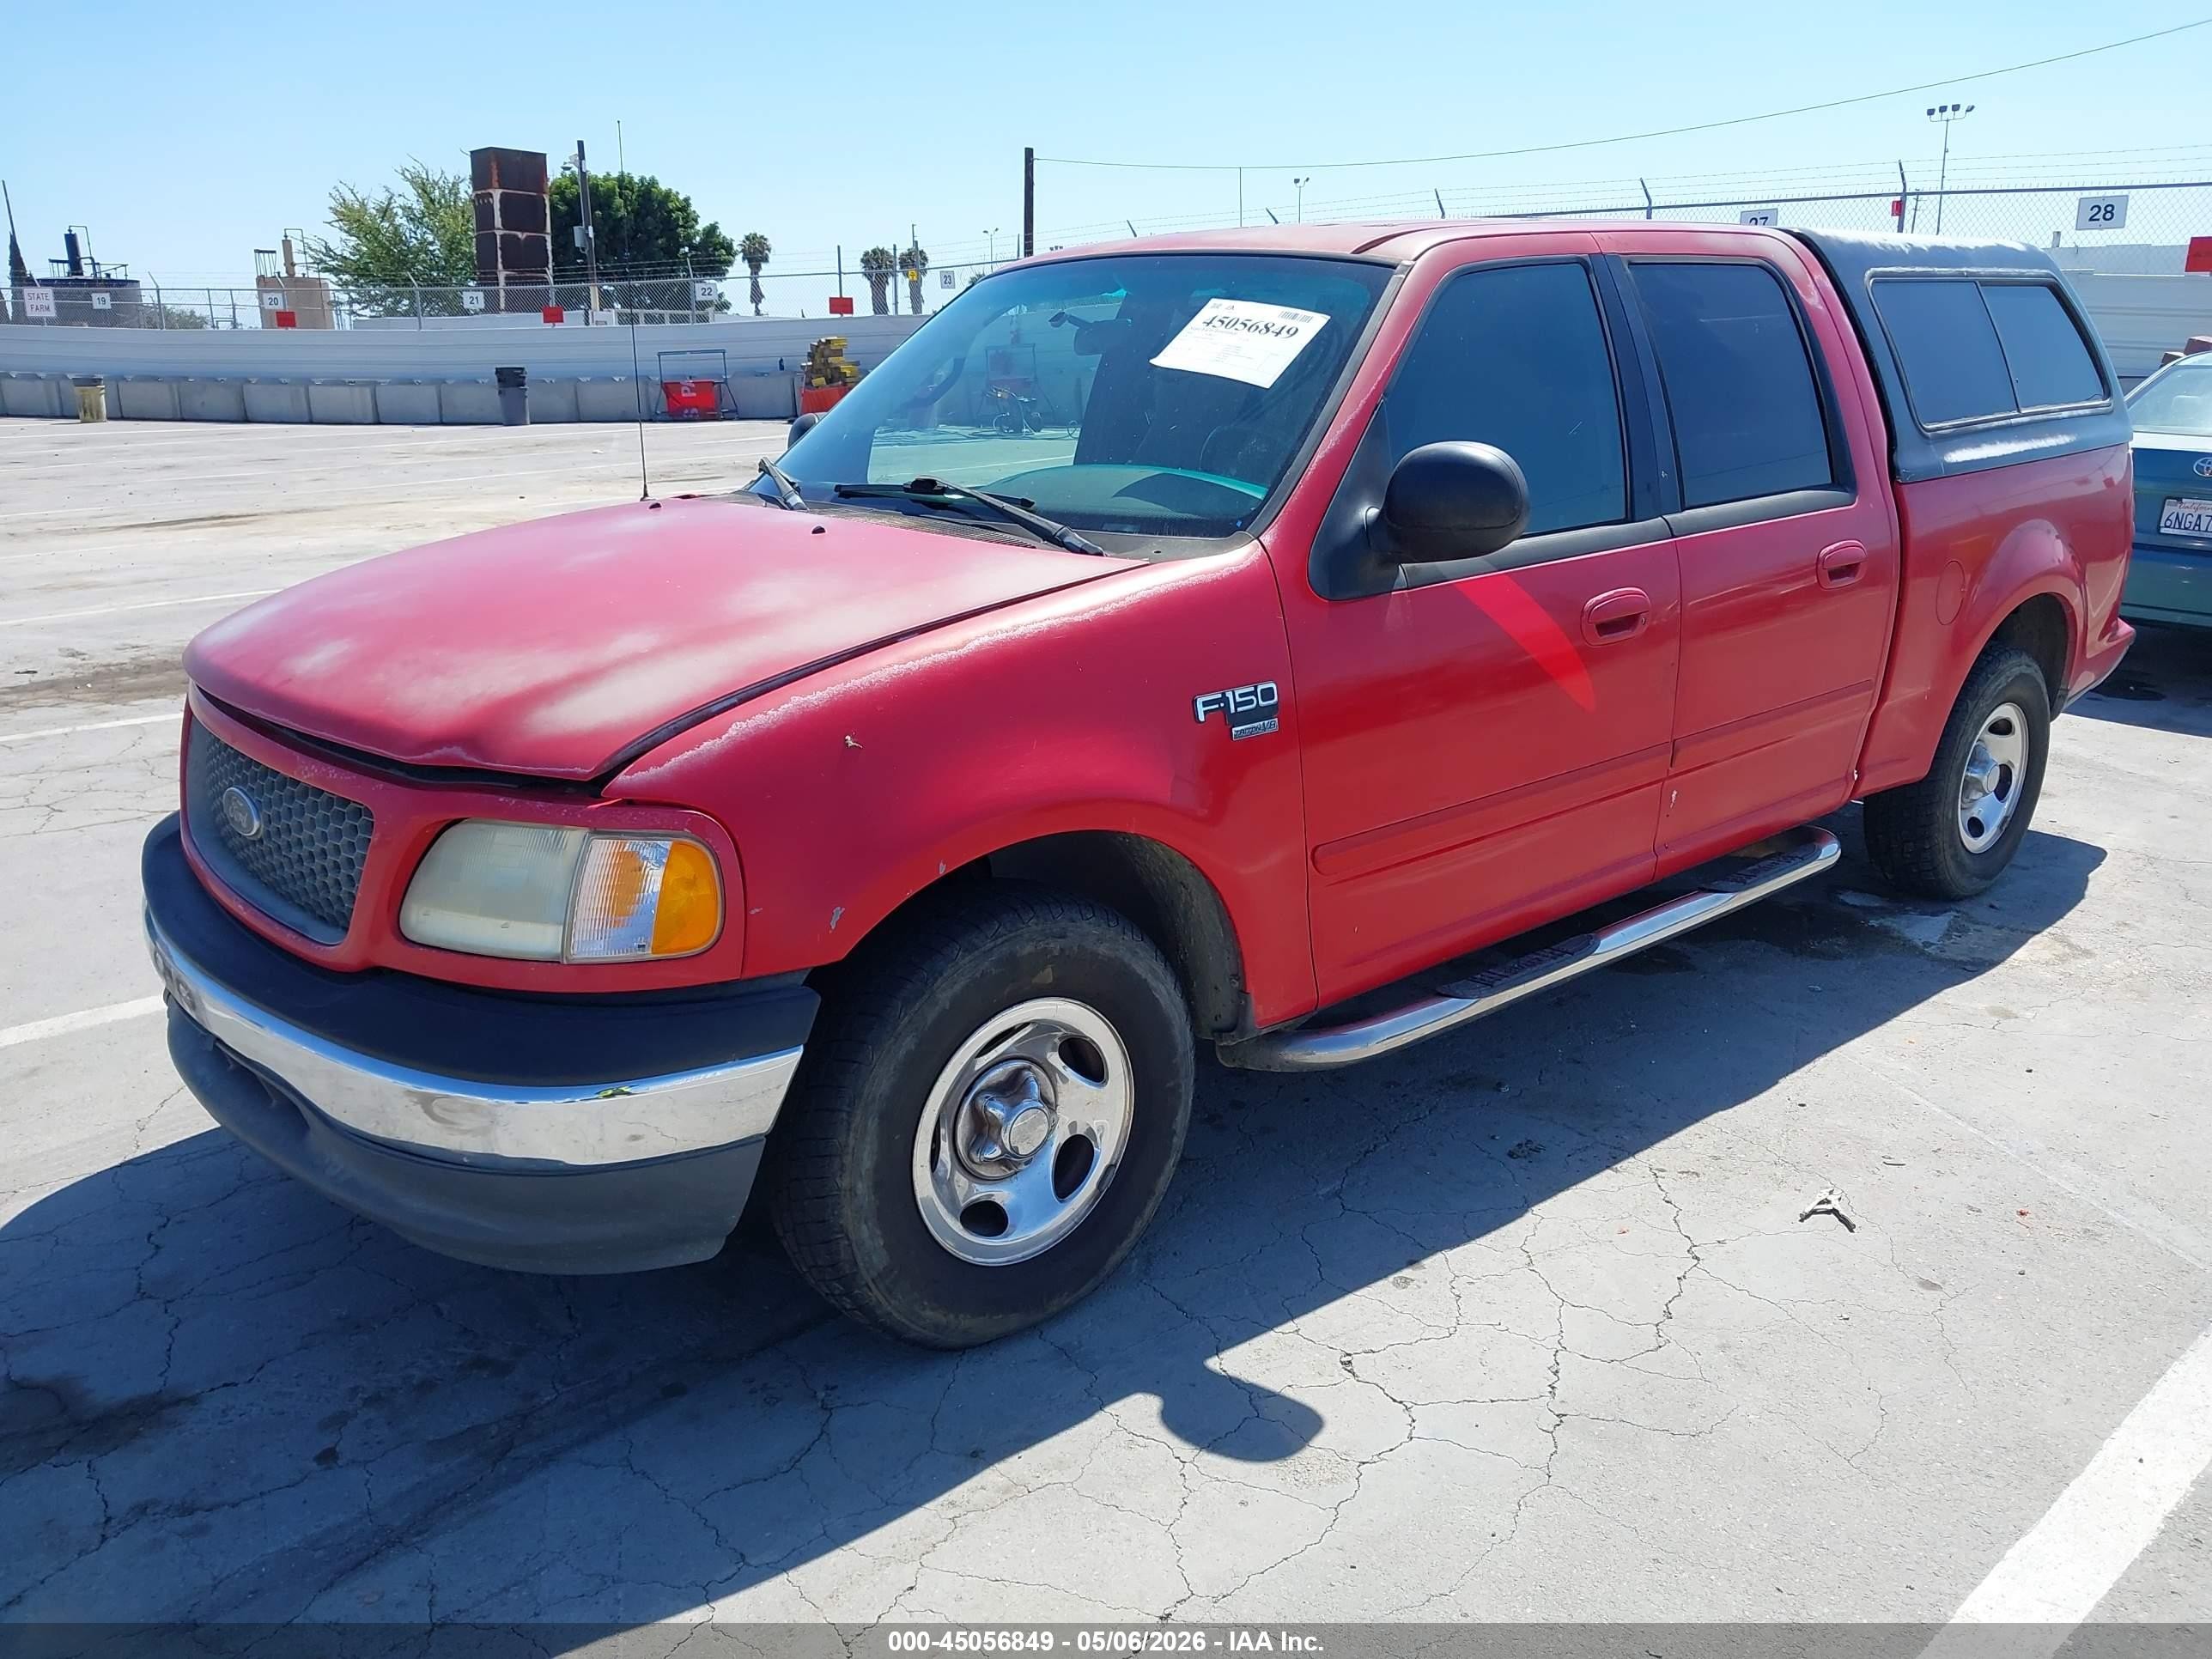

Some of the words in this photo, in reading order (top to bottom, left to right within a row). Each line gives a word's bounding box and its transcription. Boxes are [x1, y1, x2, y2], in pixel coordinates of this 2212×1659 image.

[2088, 204, 2116, 222] 28
[944, 275, 952, 285] 23
[701, 287, 713, 296] 22
[27, 292, 49, 301] STATE
[97, 296, 106, 305] 19
[469, 296, 479, 305] 21
[1202, 314, 1299, 338] 45056849
